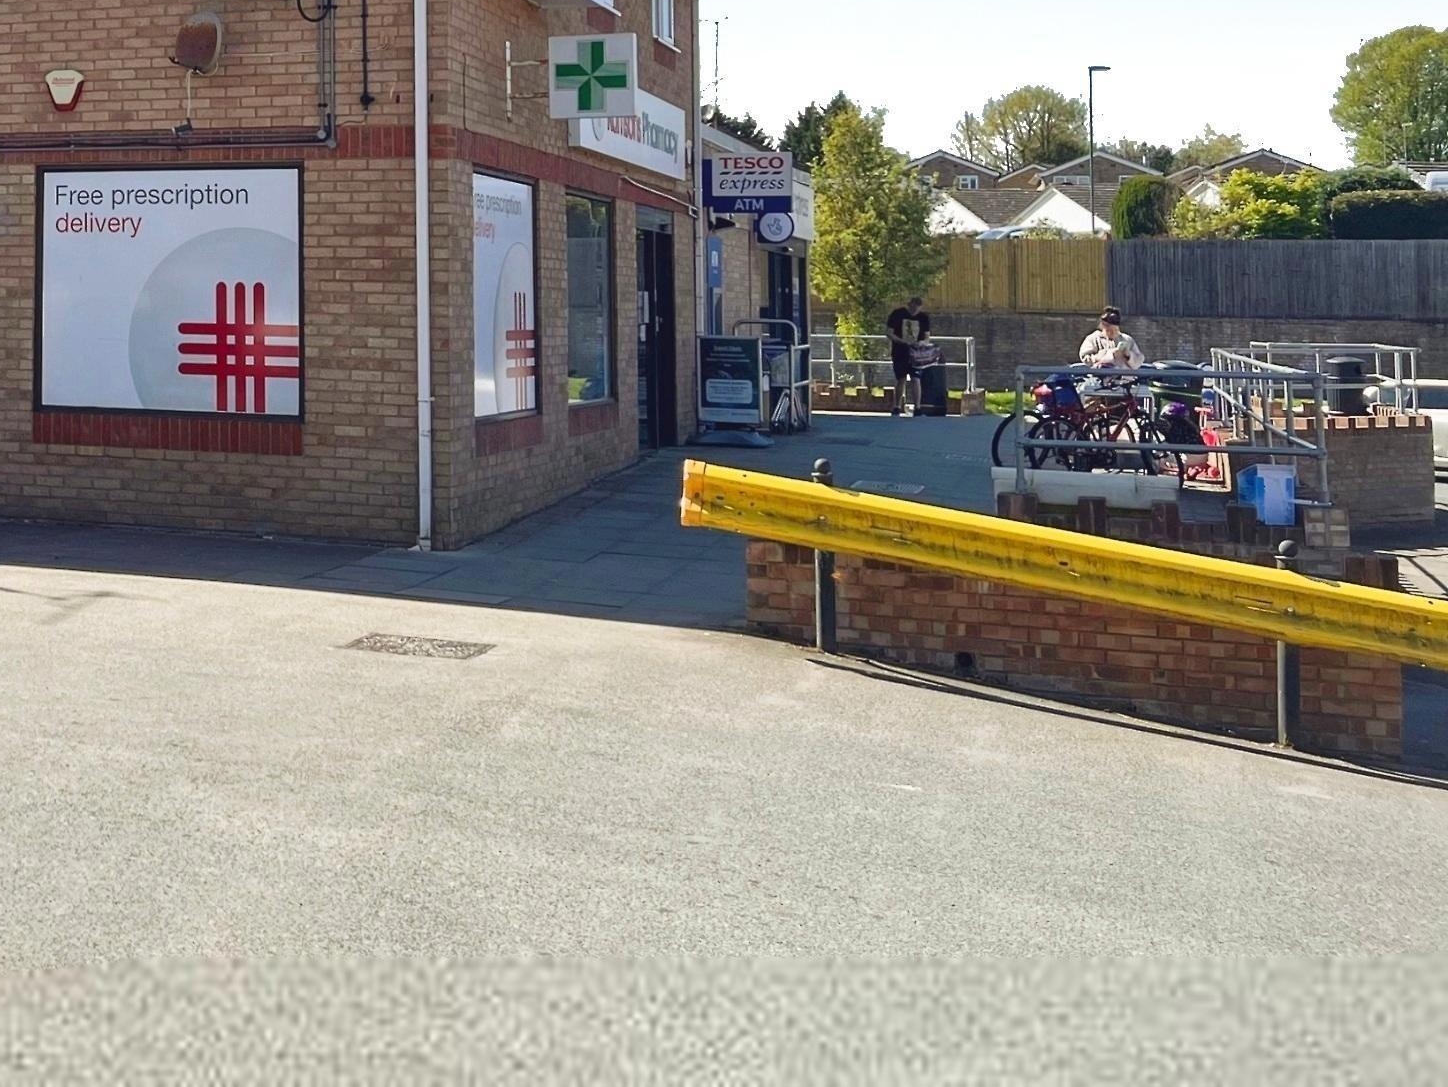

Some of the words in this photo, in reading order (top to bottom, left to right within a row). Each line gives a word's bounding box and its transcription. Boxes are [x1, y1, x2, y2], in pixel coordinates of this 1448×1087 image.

[718, 156, 784, 169] TESCO
[719, 177, 785, 194] express
[55, 184, 104, 206] Free
[111, 183, 249, 210] prescription
[485, 194, 522, 218] prescription
[733, 198, 765, 211] ATM
[55, 213, 143, 238] delivery
